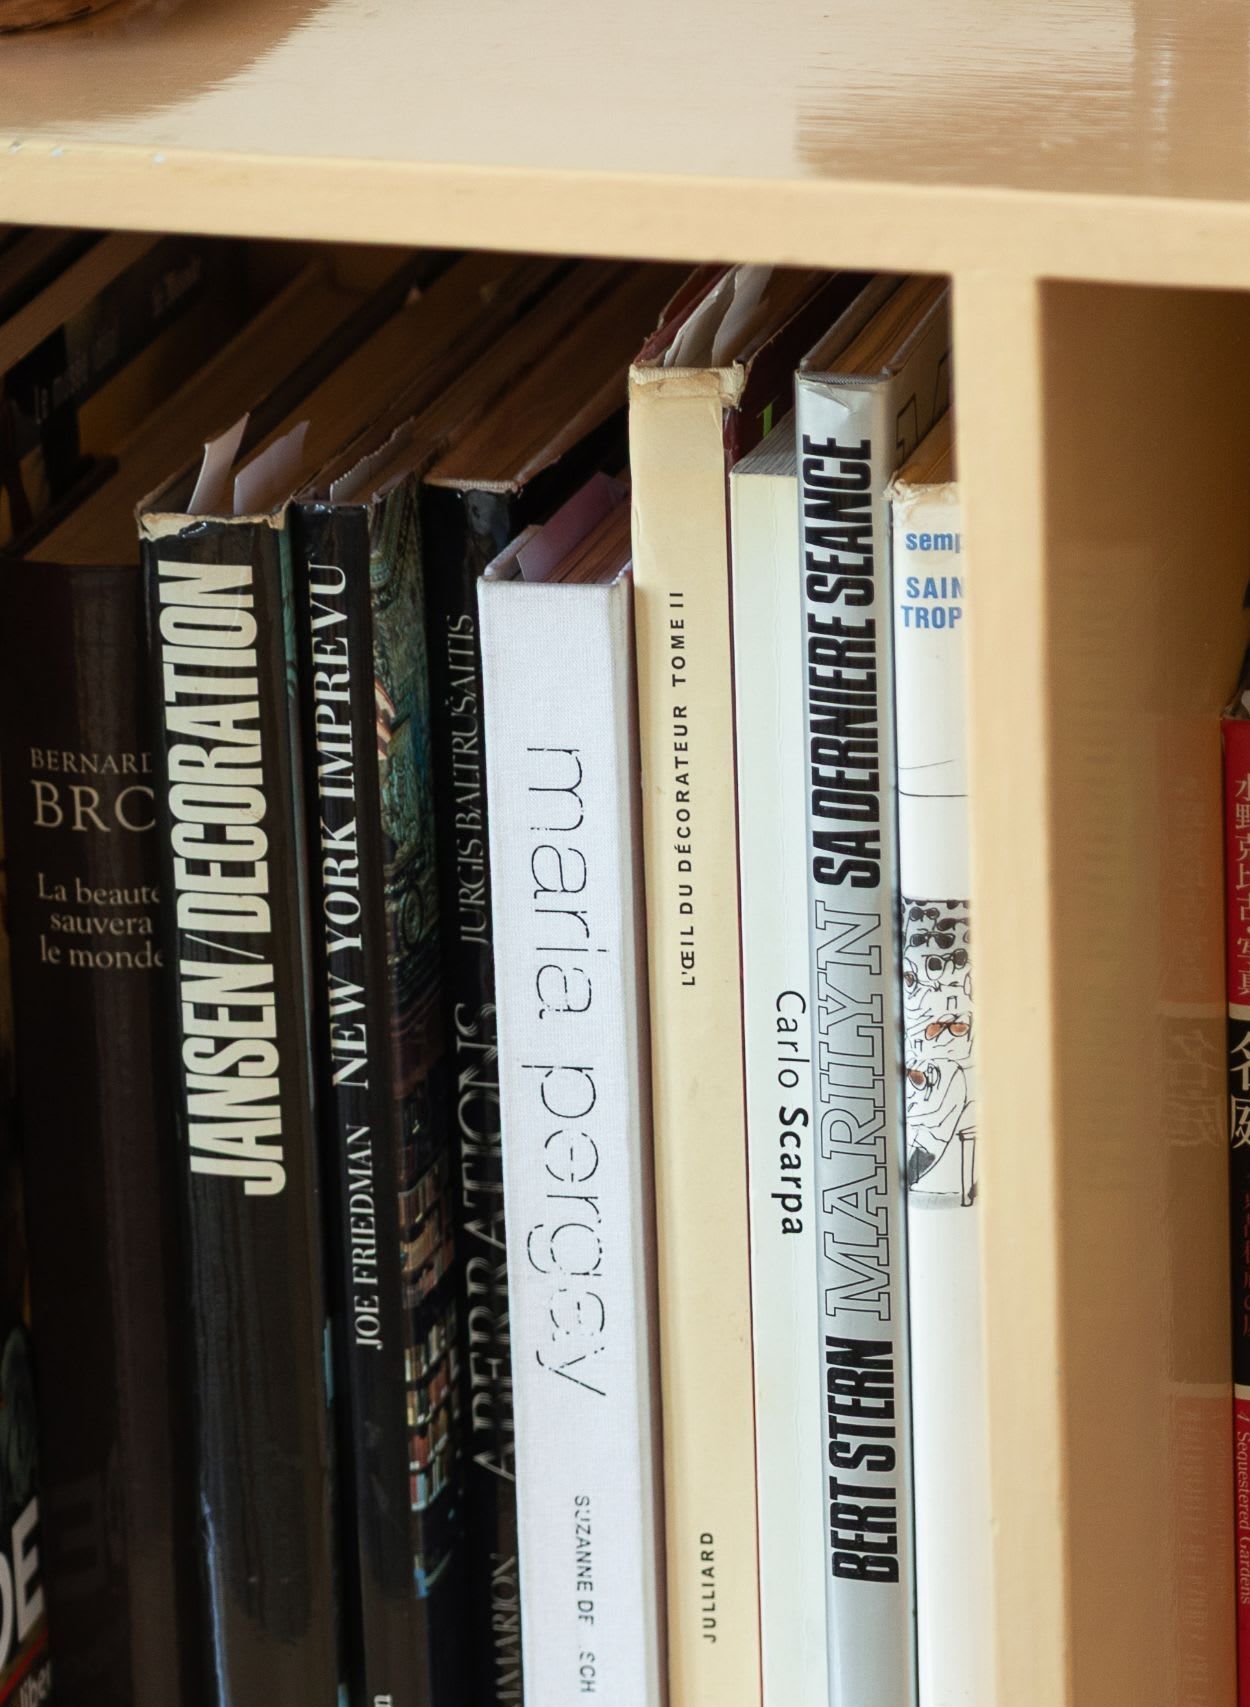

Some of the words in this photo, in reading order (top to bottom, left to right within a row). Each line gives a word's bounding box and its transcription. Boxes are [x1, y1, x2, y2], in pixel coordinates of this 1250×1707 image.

[802, 434, 876, 606] SEANCE
[670, 619, 687, 687] TOME
[900, 604, 962, 629] TROP
[307, 561, 356, 801] IMPREVU
[806, 613, 880, 823] DERNIERE
[672, 705, 693, 872] DÉCORATEUR
[37, 871, 67, 902] La
[319, 816, 362, 956] YORK
[456, 838, 490, 946] JURGIS
[528, 748, 609, 1020] maria
[678, 884, 693, 915] DU
[812, 830, 880, 889] SA
[39, 933, 61, 965] le
[49, 911, 154, 937] sauvera
[327, 971, 369, 1091] NEW
[776, 989, 811, 1089] Carlo
[815, 900, 892, 1322] MARILYN
[346, 1124, 380, 1287] FRIEDMAN
[771, 1104, 809, 1235] Scarpa
[522, 1065, 606, 1397] pergay
[354, 1296, 384, 1351] JOE
[825, 1336, 897, 1472] STERN
[574, 1495, 594, 1591] SUZANNE
[829, 1476, 900, 1584] BERT
[699, 1532, 716, 1644] JULLIARD
